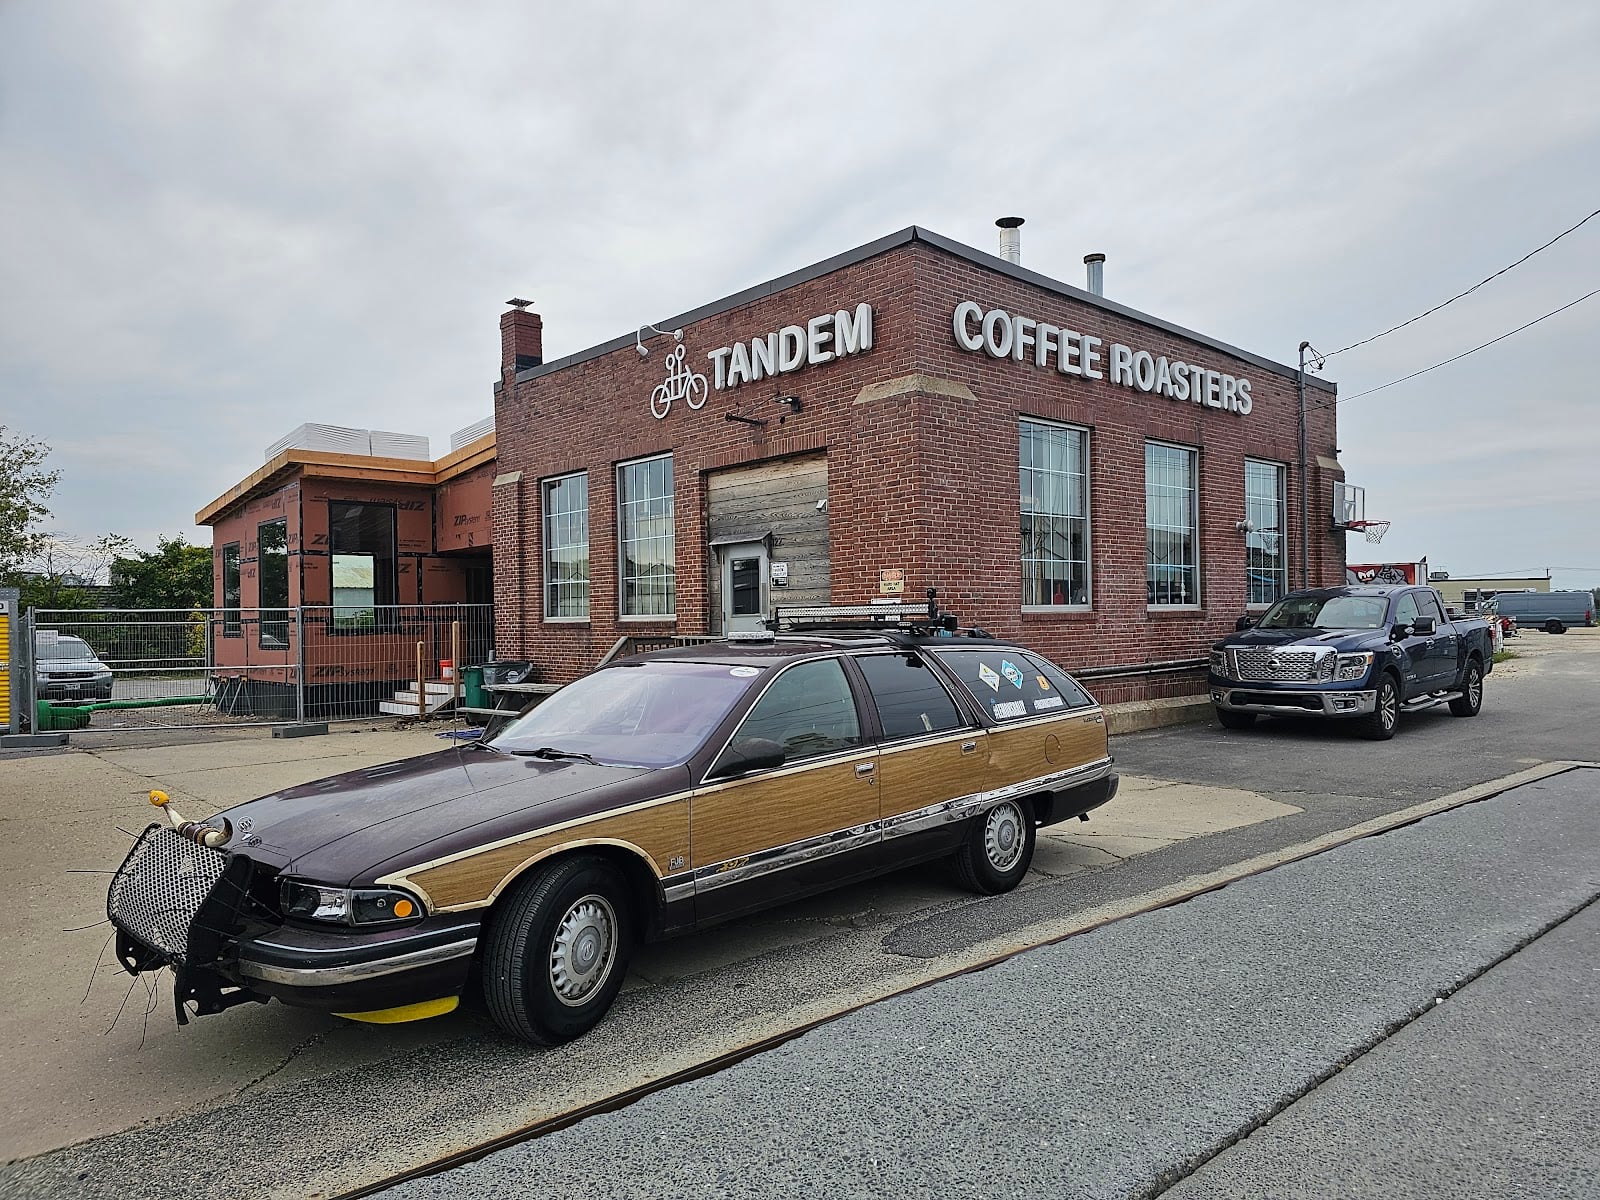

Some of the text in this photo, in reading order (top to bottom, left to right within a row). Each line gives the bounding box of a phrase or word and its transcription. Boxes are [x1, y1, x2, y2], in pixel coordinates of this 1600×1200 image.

[708, 303, 873, 390] TANDEM
[953, 301, 1253, 416] COFFEE ROASTERS
